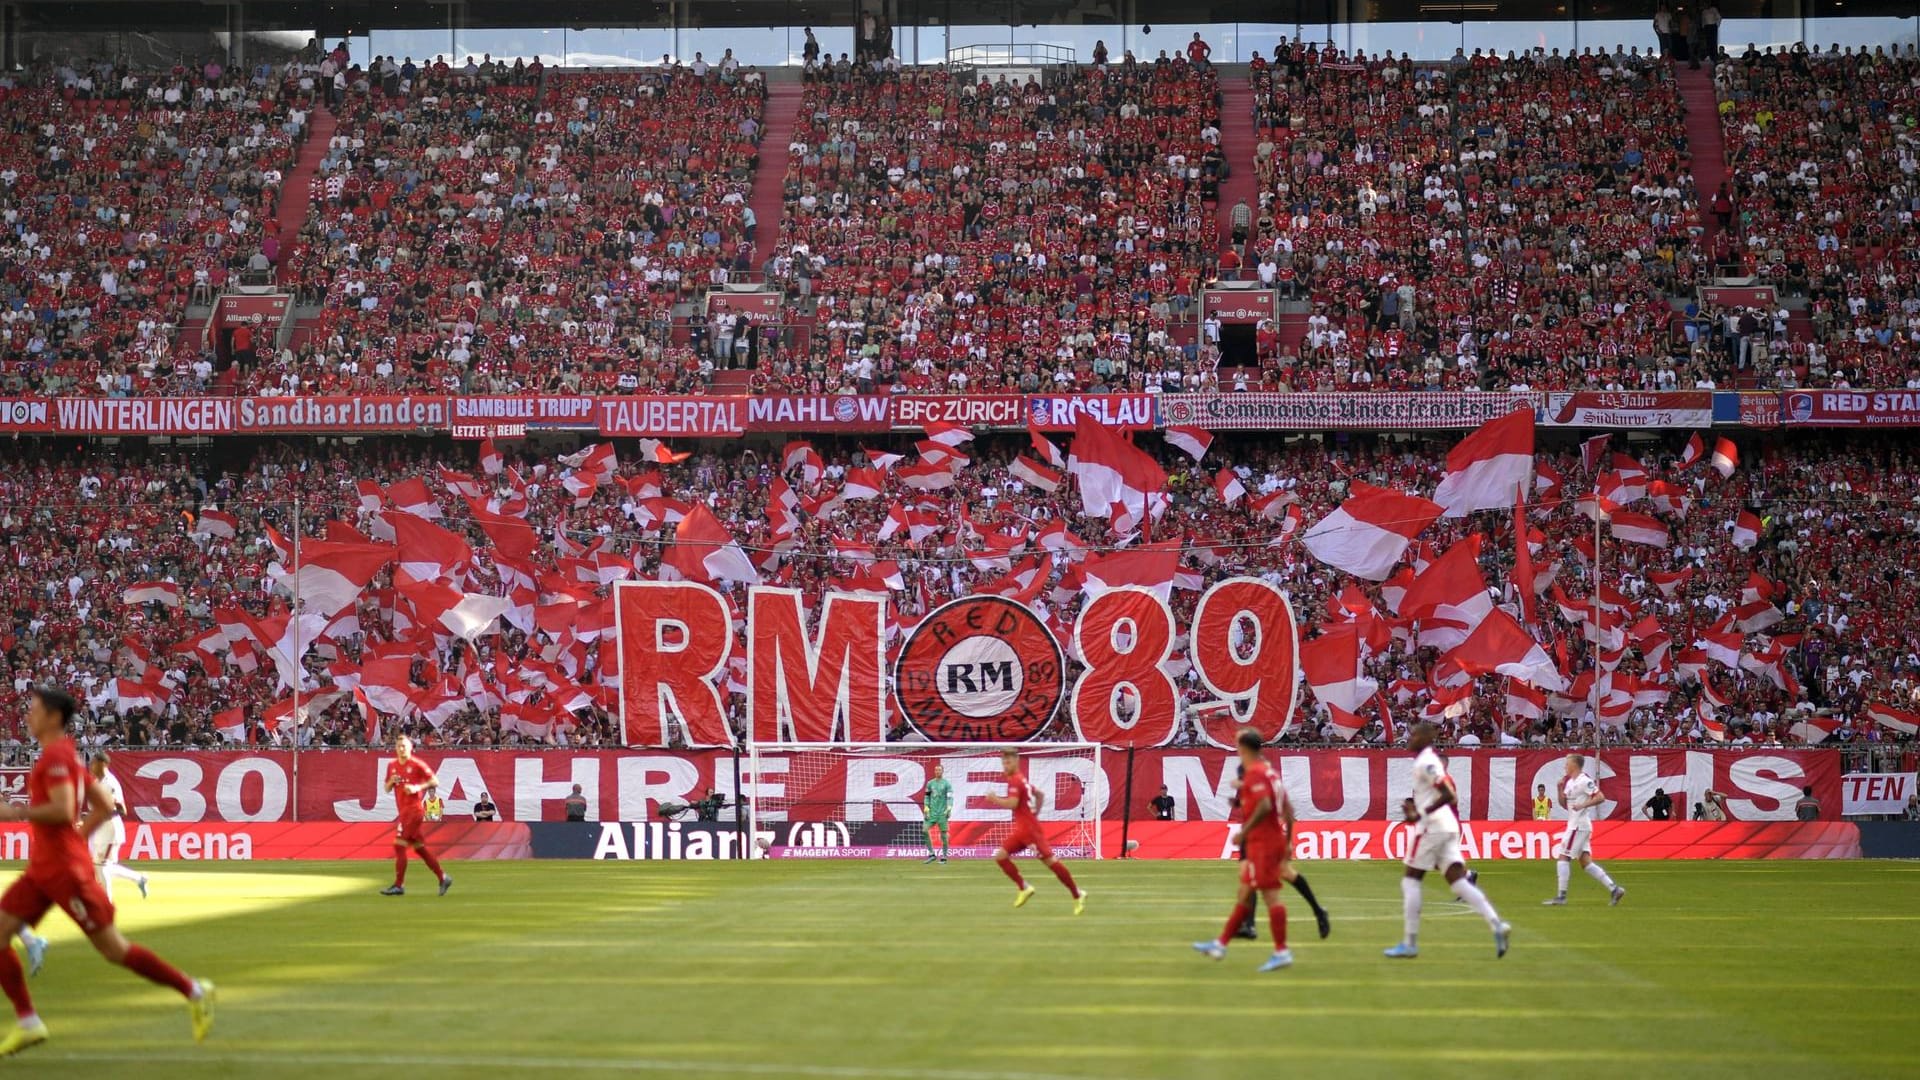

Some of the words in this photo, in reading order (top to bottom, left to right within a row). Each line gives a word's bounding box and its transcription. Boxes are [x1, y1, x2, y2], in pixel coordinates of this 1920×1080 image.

[0, 401, 47, 424] ION
[241, 399, 442, 426] Sandharlanden
[456, 398, 534, 416] BAMBULE
[538, 398, 592, 416] TRUPP
[900, 399, 940, 422] BFC
[943, 397, 1018, 421] ZÜRICH
[1052, 396, 1151, 425] RÖSLAU
[1207, 398, 1330, 418] Commando
[1339, 397, 1495, 423] Unterfranken
[1620, 393, 1658, 409] Jahre
[1822, 394, 1868, 412] RED
[57, 400, 232, 430] WINTERLINGEN
[602, 401, 743, 432] TAUBERTAL
[1583, 411, 1648, 426] Südkurve
[1866, 415, 1900, 423] Worms
[1902, 415, 1909, 423] &
[452, 425, 486, 437] LETZTE
[497, 424, 526, 436] REIHE
[932, 606, 1017, 645] RED
[614, 578, 886, 749] RM
[1073, 575, 1301, 749] 89
[1028, 661, 1055, 683] 89
[946, 661, 1015, 693] RM
[911, 689, 1049, 740] MUNICHS
[134, 757, 288, 823] 30
[334, 755, 790, 823] JAHRE
[846, 755, 1110, 821] RED
[1842, 776, 1905, 801] TEN
[130, 824, 252, 860] Arena
[794, 849, 840, 857] MAGENTA
[842, 849, 871, 857] SPORT
[947, 849, 976, 857] SPORT
